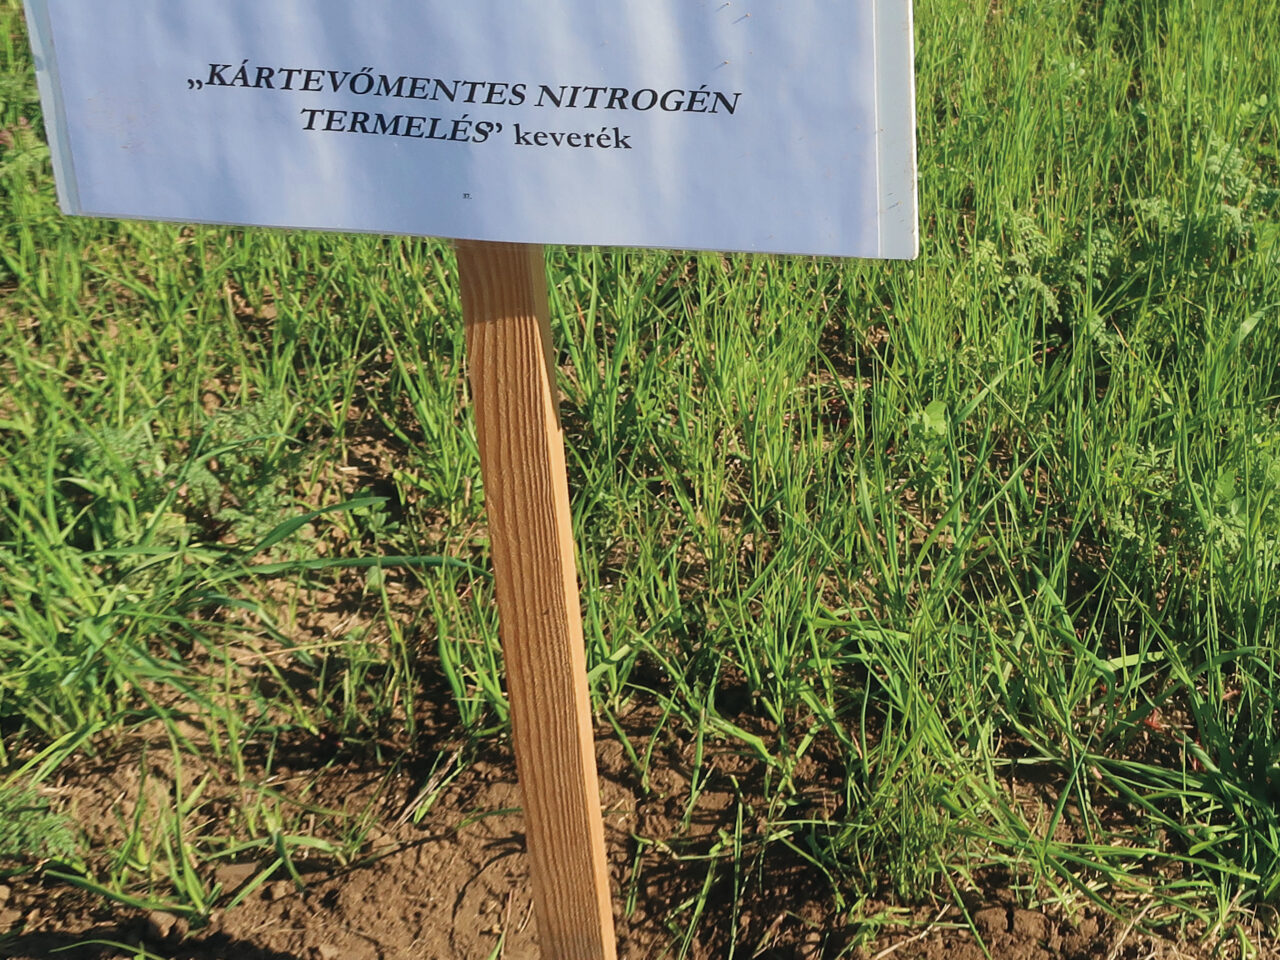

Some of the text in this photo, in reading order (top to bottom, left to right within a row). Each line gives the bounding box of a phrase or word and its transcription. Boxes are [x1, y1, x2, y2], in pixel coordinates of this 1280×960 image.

[187, 59, 742, 115] „KÁRTEVŐMENTES NITROGÉN
[513, 123, 633, 150] keverék
